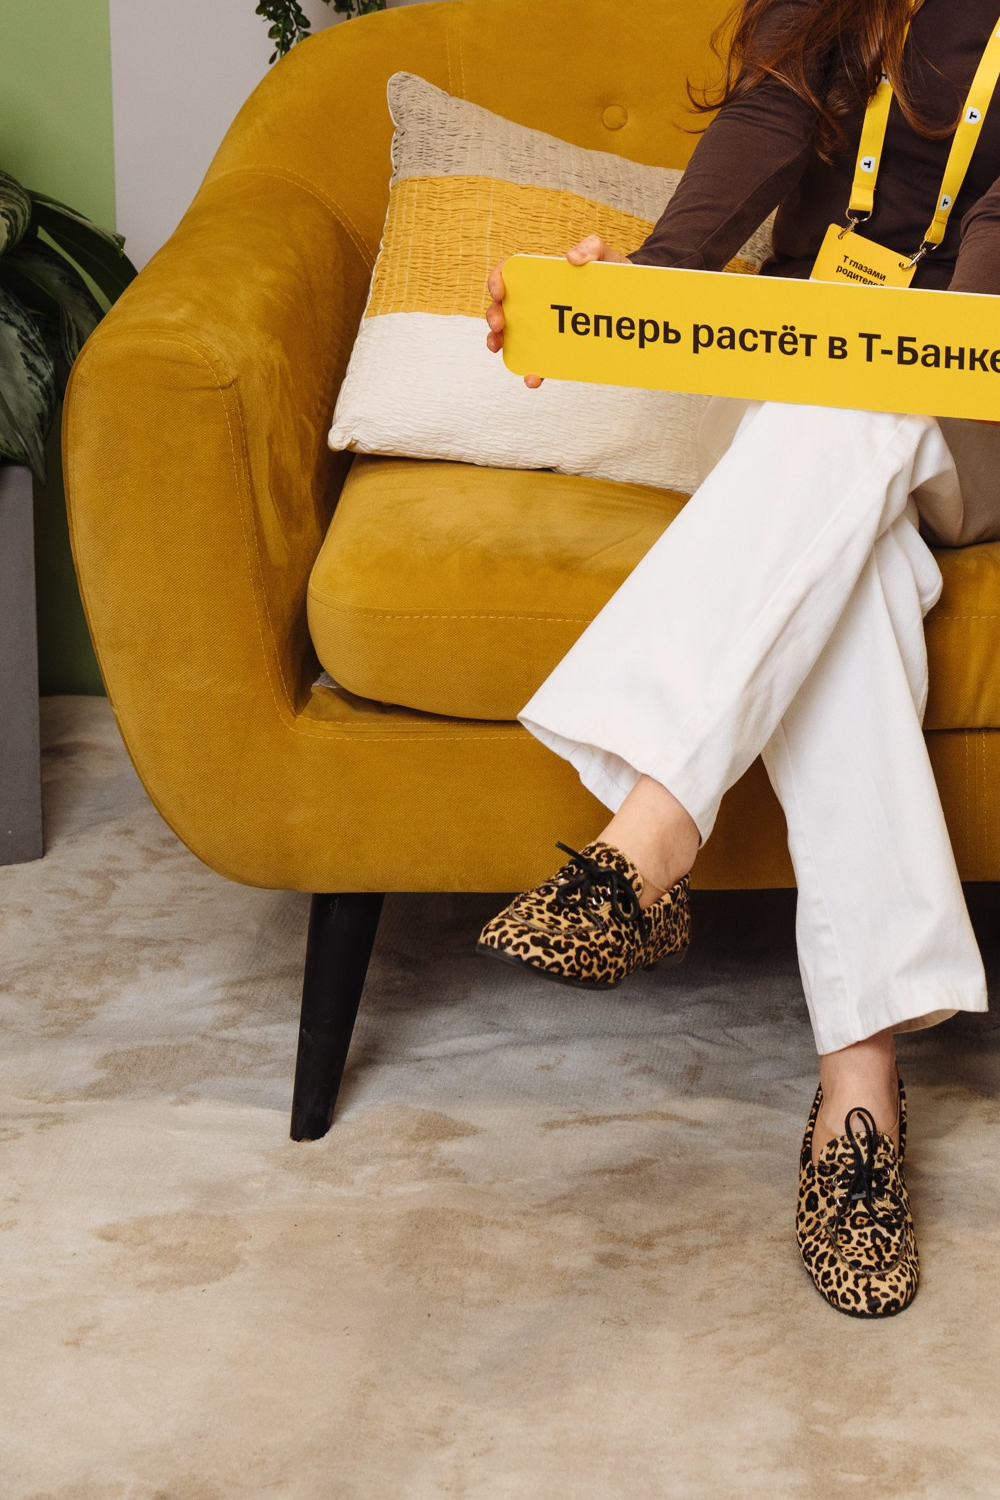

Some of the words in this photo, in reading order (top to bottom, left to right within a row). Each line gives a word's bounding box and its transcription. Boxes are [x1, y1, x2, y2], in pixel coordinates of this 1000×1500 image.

[836, 265, 885, 287] родител
[843, 254, 850, 263] Т
[848, 258, 887, 282] глазами
[550, 304, 682, 349] Теперь
[692, 321, 818, 357] растёт
[828, 335, 848, 360] в
